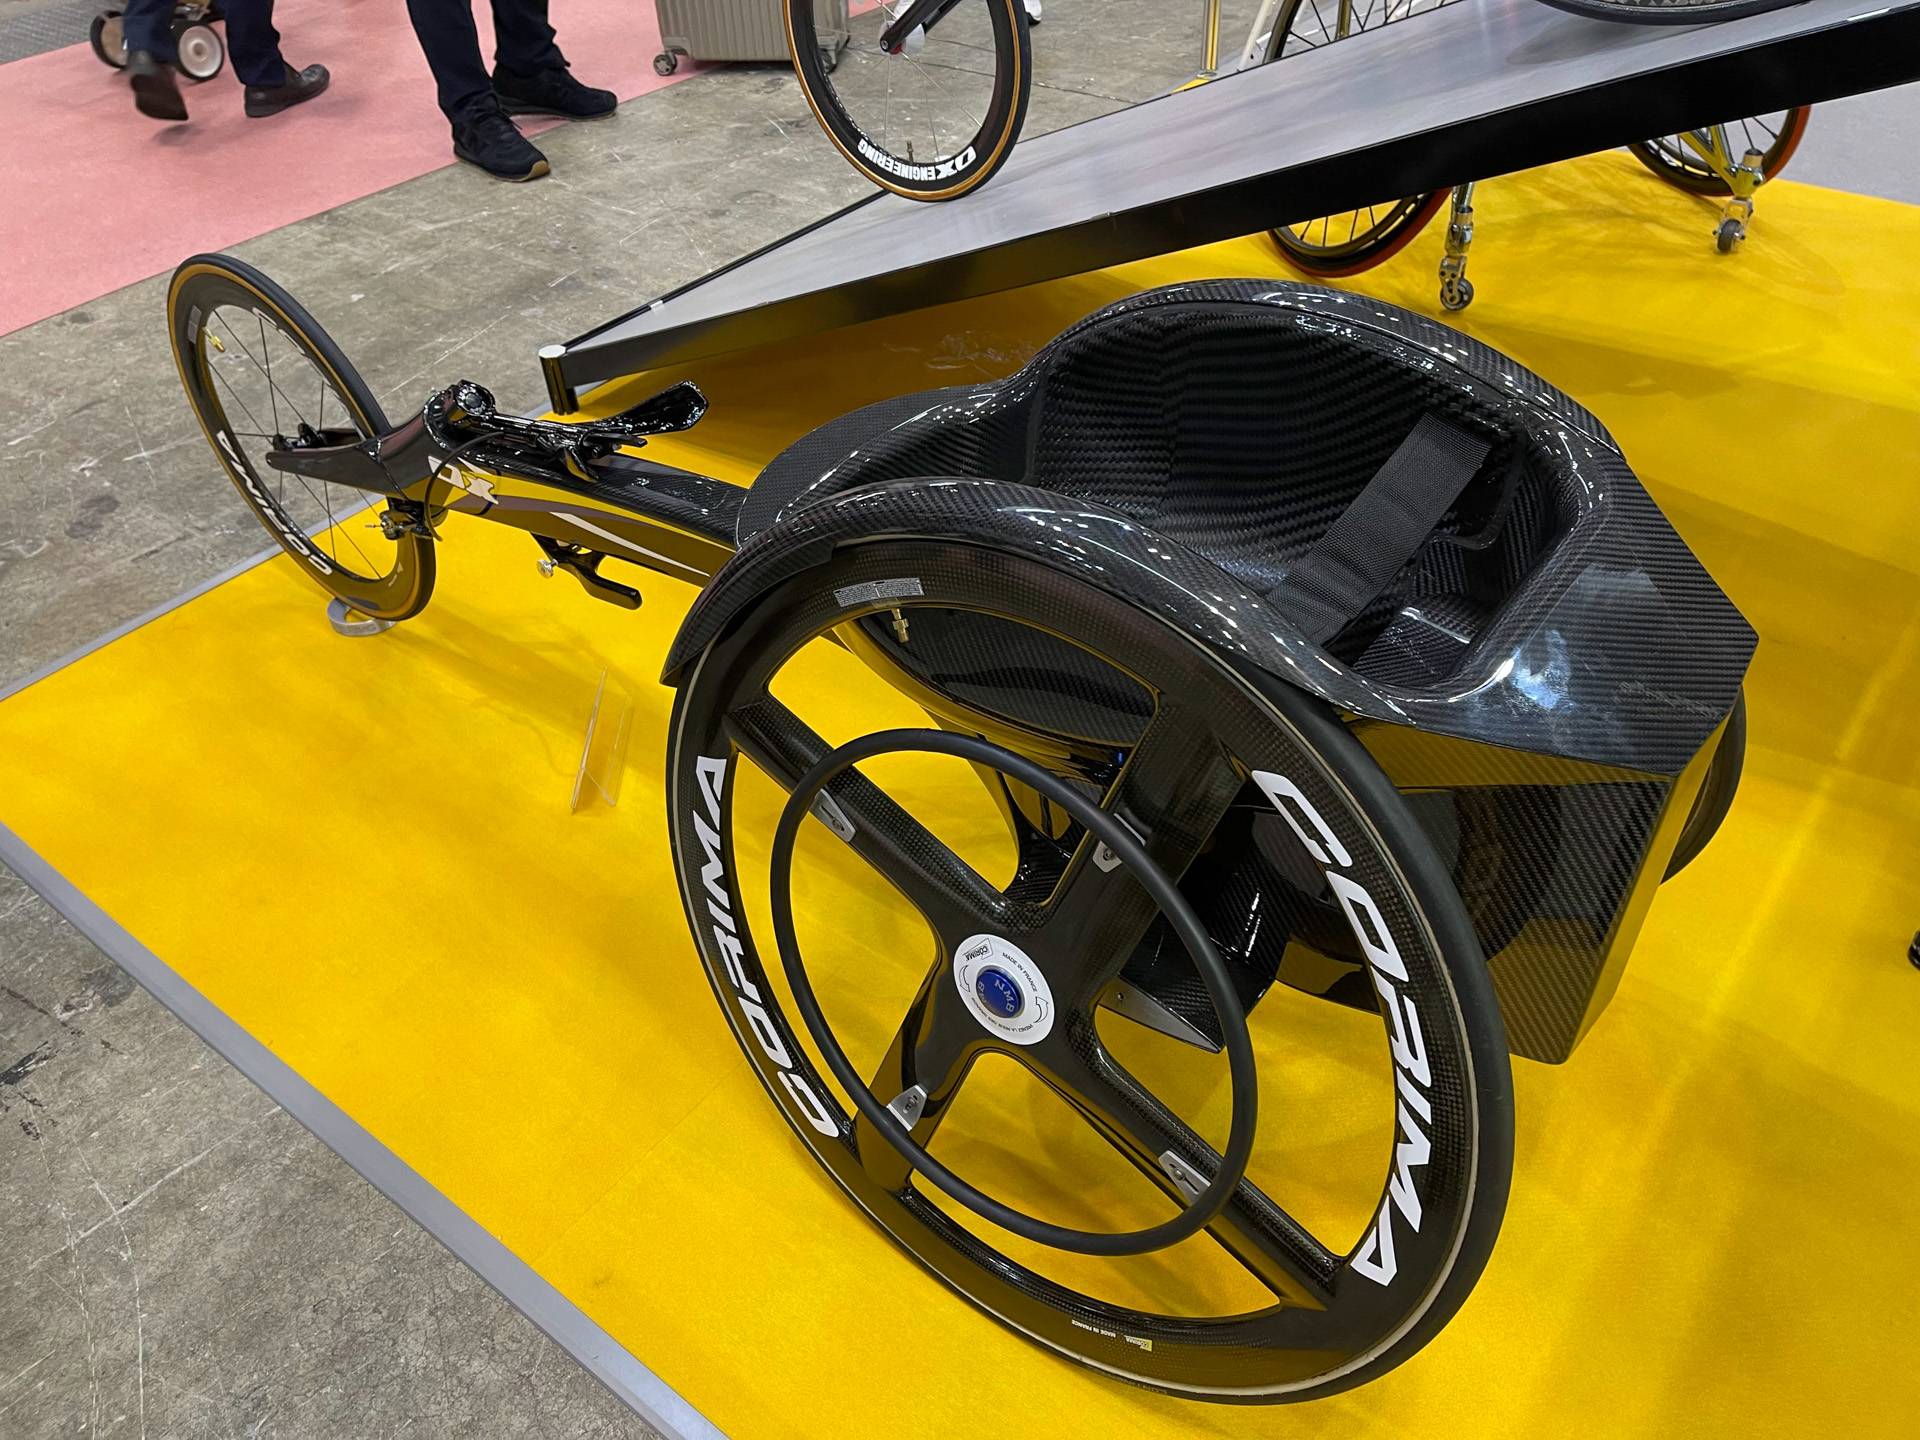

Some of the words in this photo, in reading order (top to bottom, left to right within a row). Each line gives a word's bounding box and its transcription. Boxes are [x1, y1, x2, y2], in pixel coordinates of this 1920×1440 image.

[857, 138, 937, 181] ENGINEERING
[216, 429, 333, 576] CORIMA
[692, 755, 839, 1139] CORIMA
[965, 944, 989, 961] CORIMA
[1002, 952, 1017, 966] MADE
[1017, 963, 1024, 972] IN
[1022, 969, 1038, 993] FRANCE
[994, 979, 1015, 1012] NMB
[1018, 1023, 1033, 1033] PRENEZ
[1250, 769, 1432, 1287] CORIMA
[1071, 1318, 1093, 1332] FRANCE
[1092, 1326, 1100, 1334] IN
[1100, 1329, 1117, 1338] MADE
